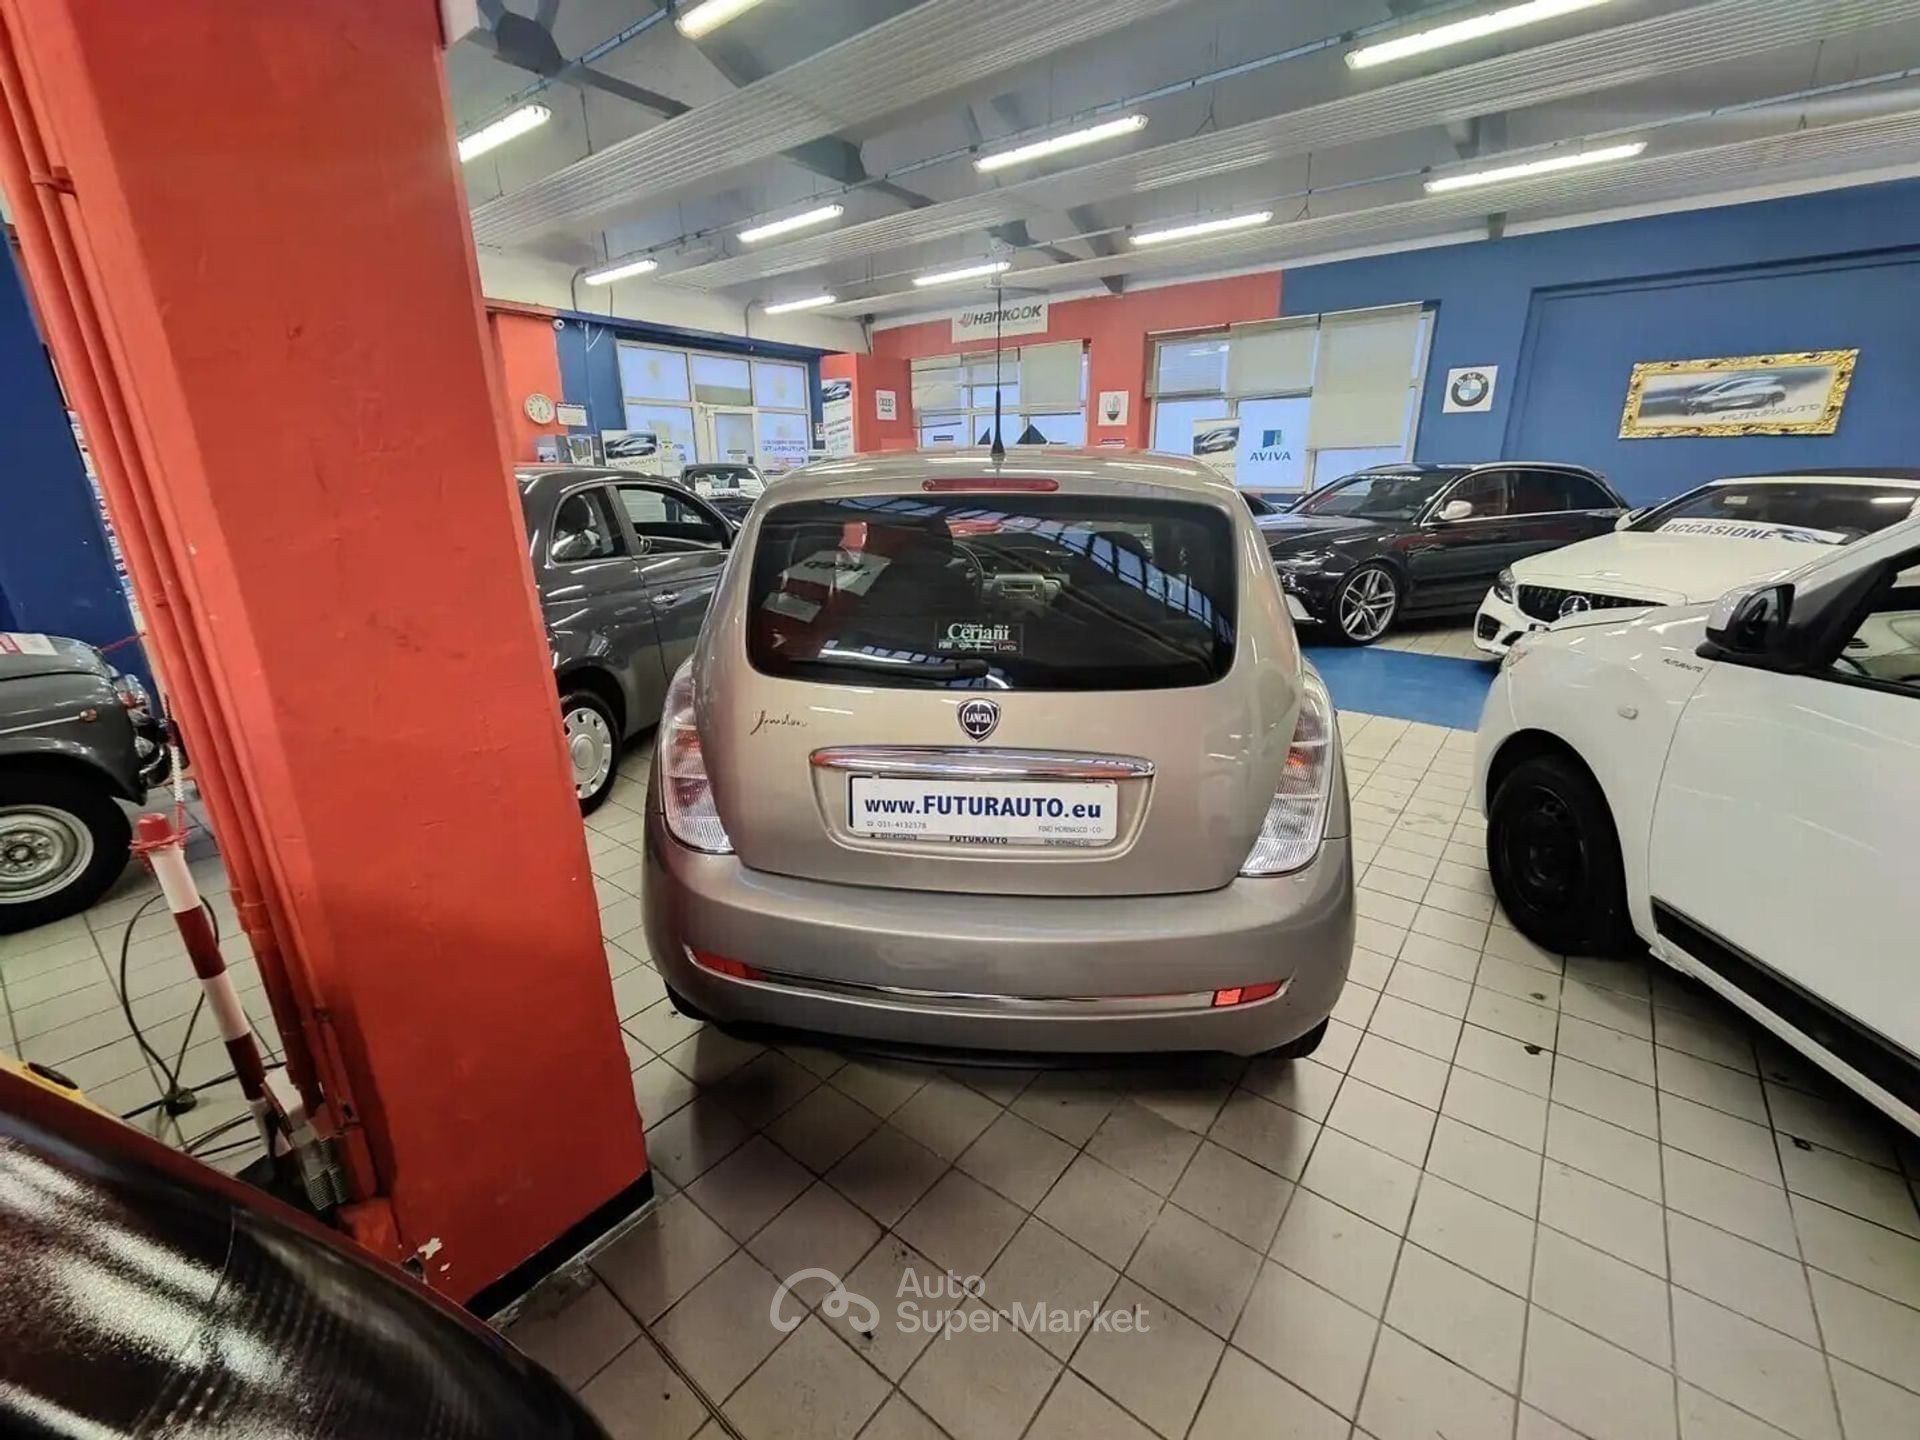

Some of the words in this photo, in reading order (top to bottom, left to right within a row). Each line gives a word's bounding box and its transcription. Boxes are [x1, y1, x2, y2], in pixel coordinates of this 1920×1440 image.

[1249, 451, 1291, 462] AVIVA
[1662, 523, 1776, 539] OCCASIONE
[966, 712, 991, 724] LANCIA
[865, 795, 1101, 819] www.FUTURAUTO.eu
[949, 834, 1008, 845] FUTURAUTO
